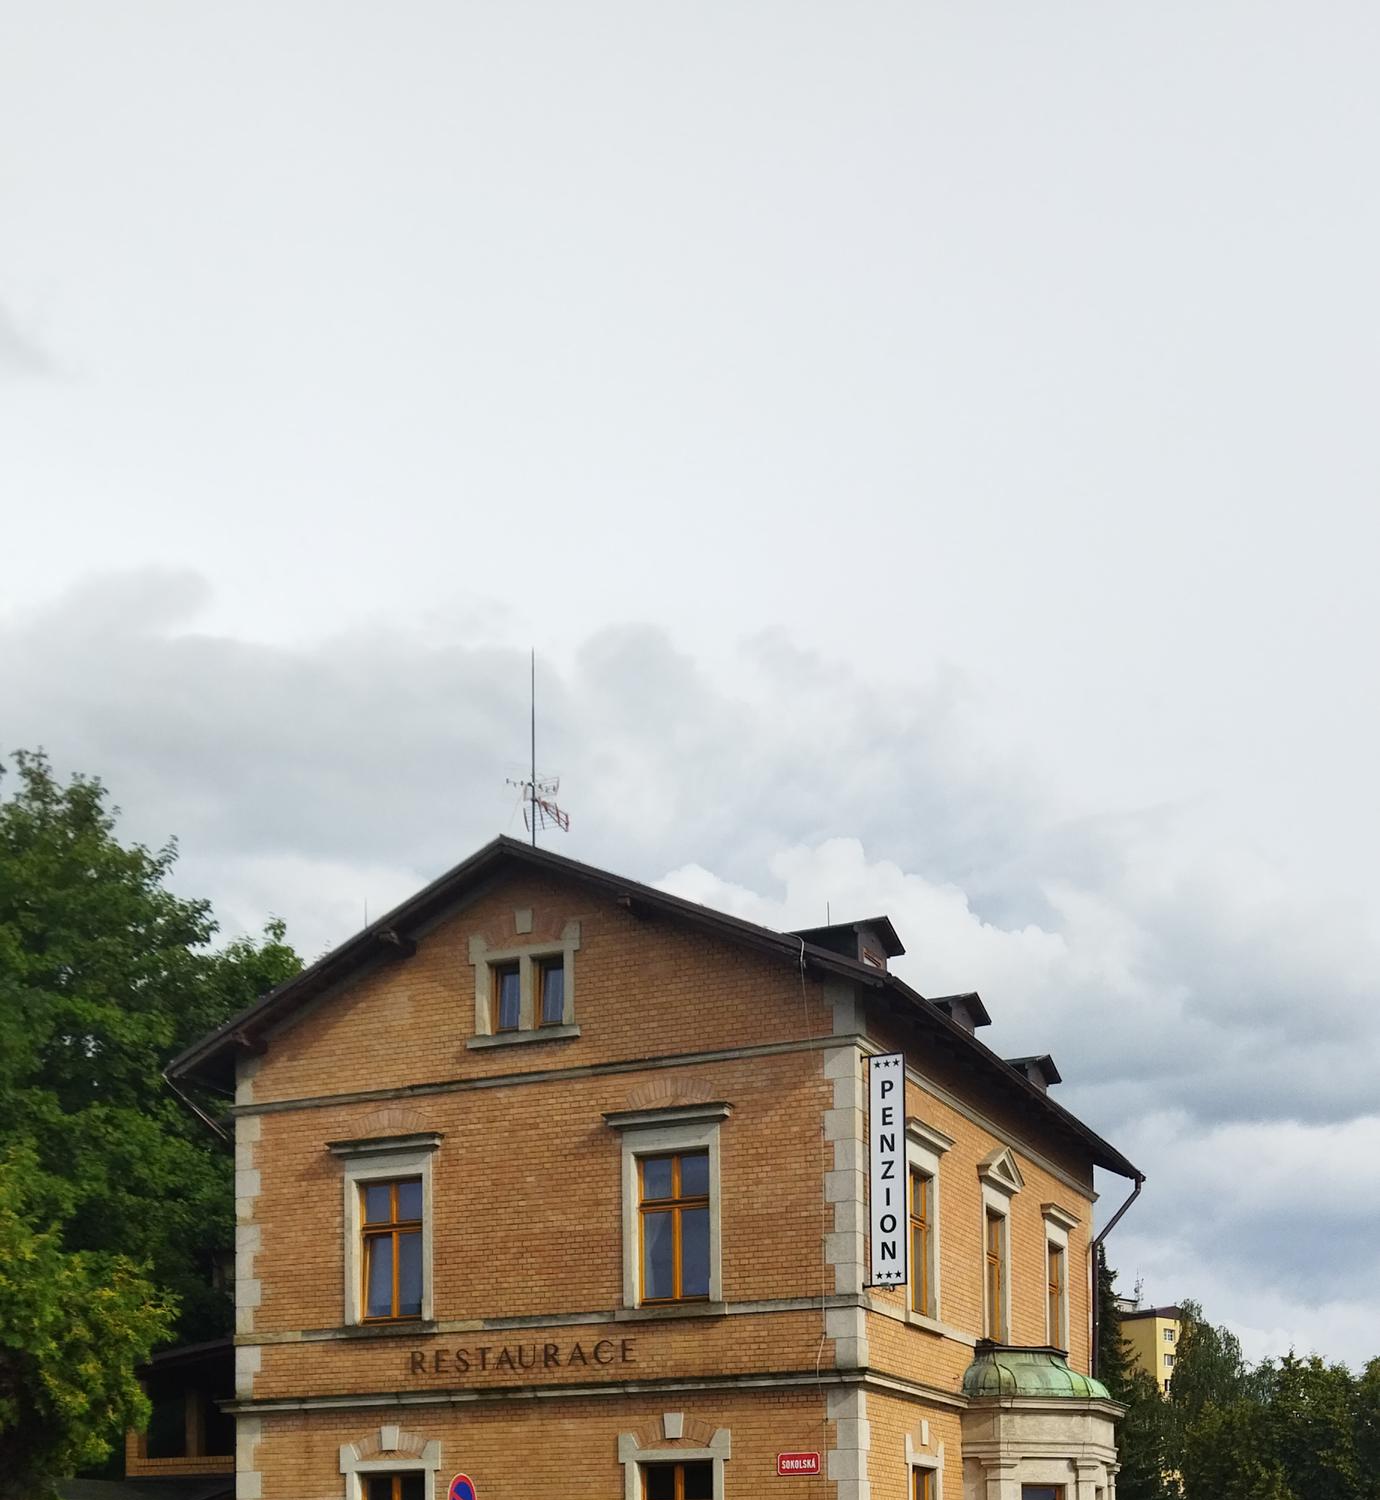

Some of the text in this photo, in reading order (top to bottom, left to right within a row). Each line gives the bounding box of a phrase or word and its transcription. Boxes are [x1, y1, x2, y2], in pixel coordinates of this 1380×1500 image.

[879, 1080, 897, 1260] PENZION
[410, 1338, 637, 1375] RESTAURACE
[782, 1458, 816, 1469] SOKOLSKÁ
